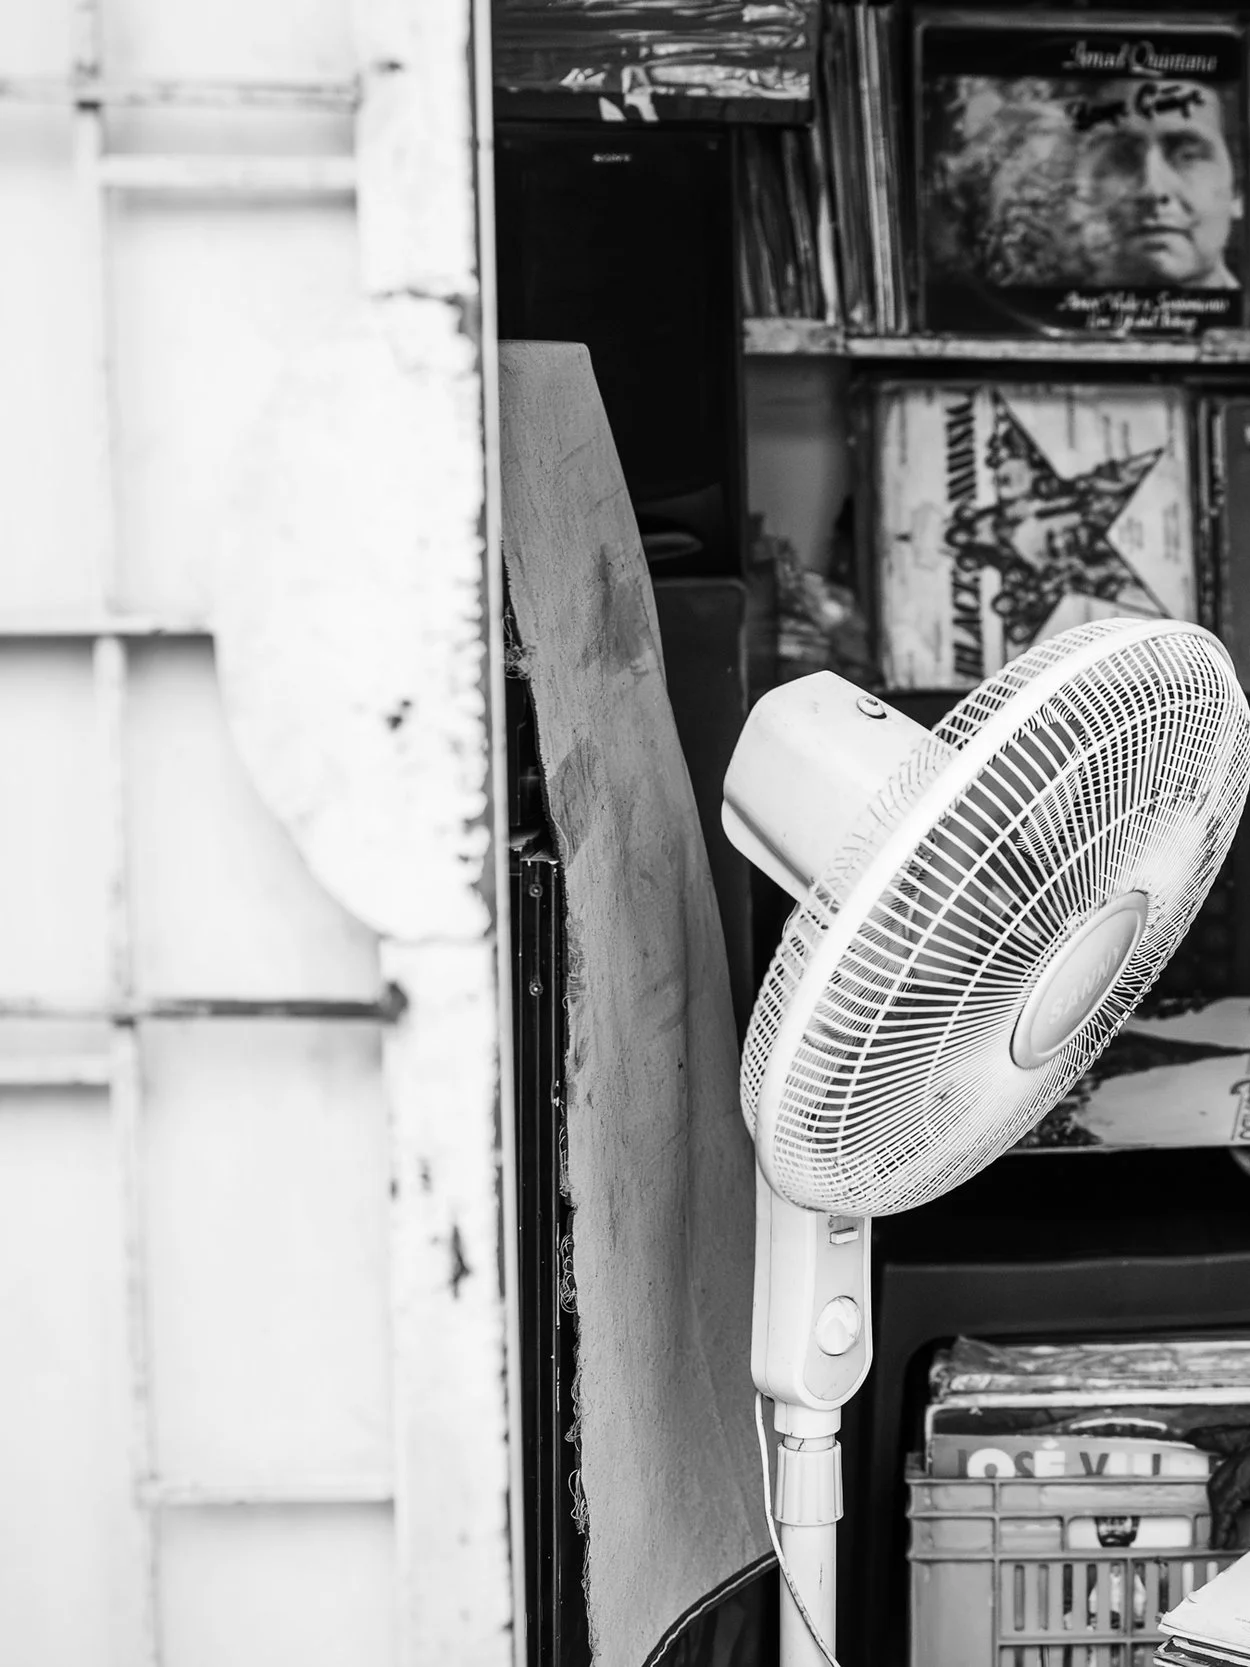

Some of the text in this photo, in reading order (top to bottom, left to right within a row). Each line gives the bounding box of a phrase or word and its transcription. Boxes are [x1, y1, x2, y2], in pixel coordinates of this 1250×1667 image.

[593, 153, 631, 163] SONY
[944, 391, 984, 680] BLACK MUSIC
